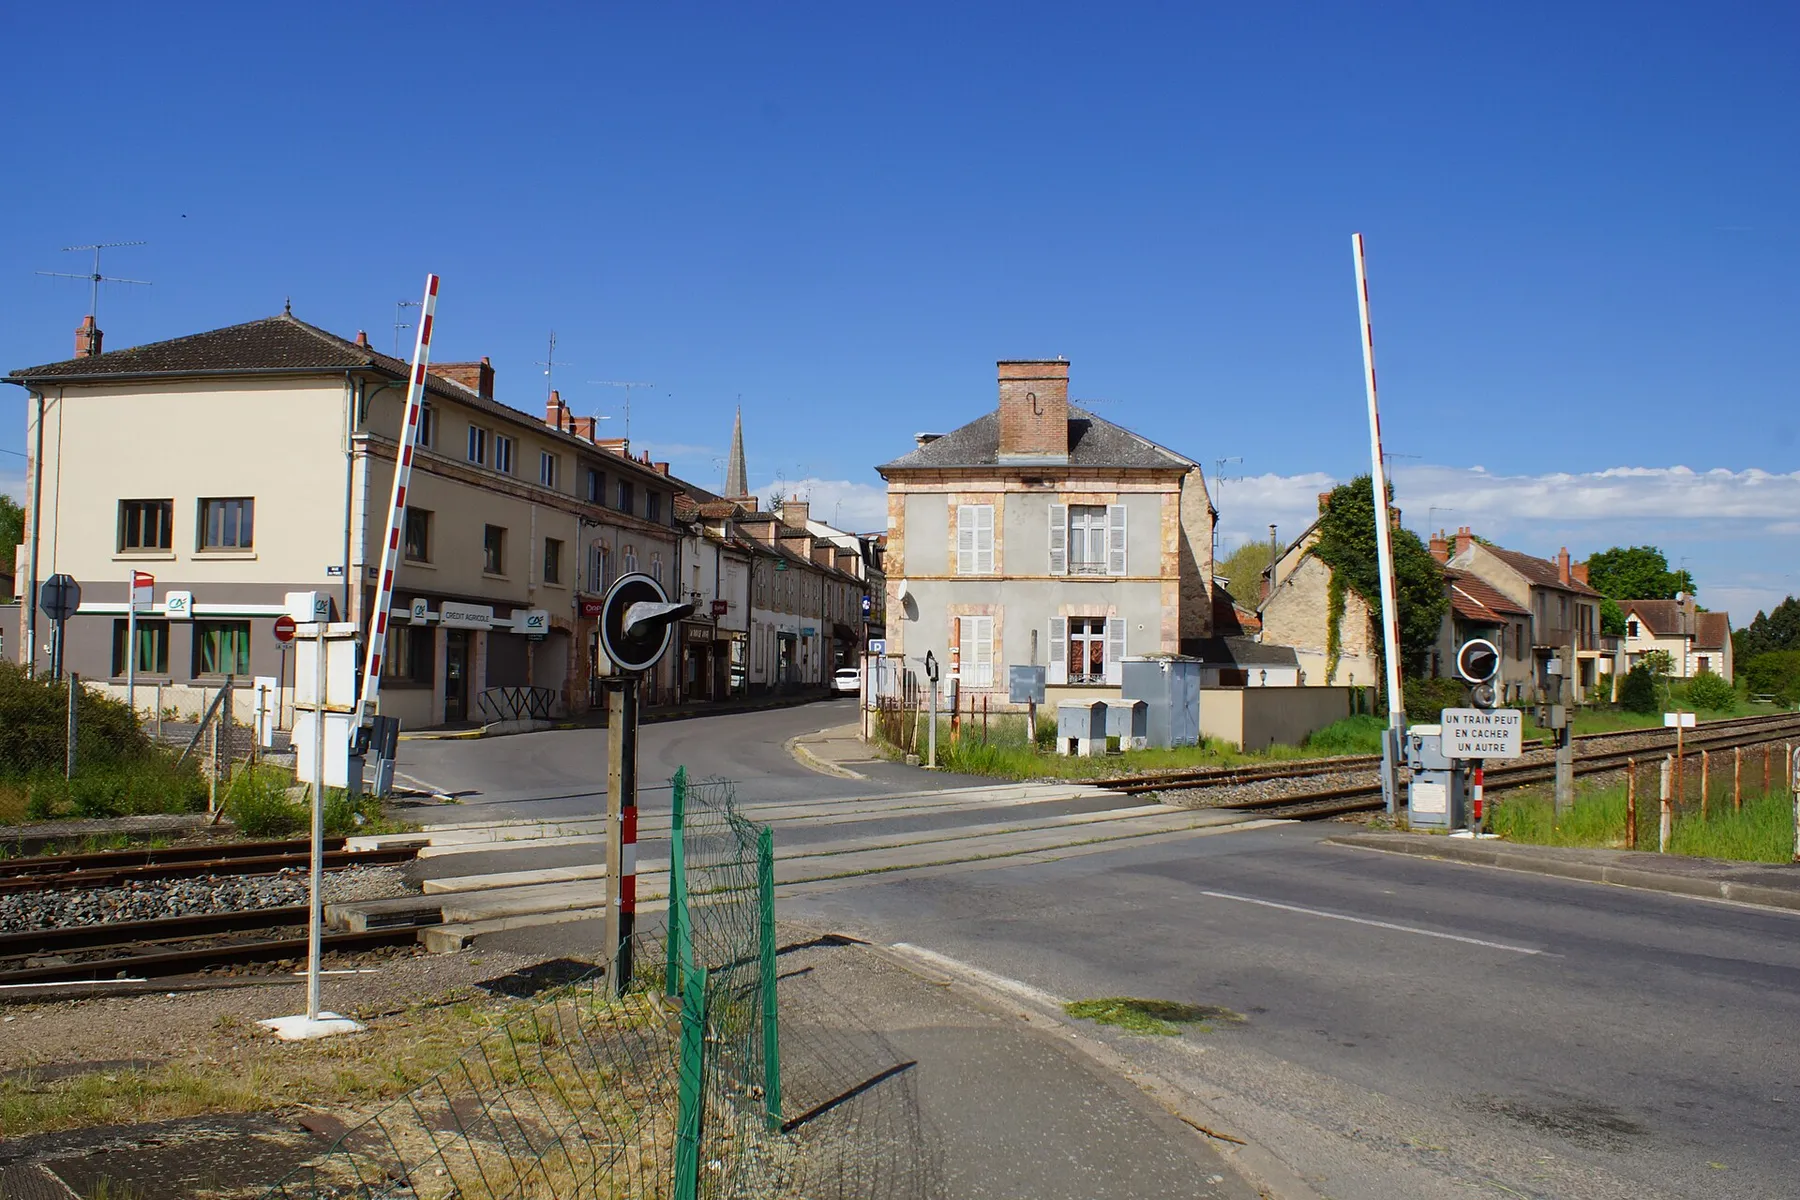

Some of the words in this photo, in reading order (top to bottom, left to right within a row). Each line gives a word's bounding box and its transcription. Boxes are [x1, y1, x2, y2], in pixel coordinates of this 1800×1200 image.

[465, 613, 490, 622] AGRICOLE
[874, 642, 882, 652] P
[1446, 715, 1459, 724] UN
[1463, 715, 1491, 724] TRAIN
[1494, 716, 1519, 725] PEUT
[1455, 729, 1468, 738] EN
[1471, 729, 1509, 738] CACHER
[1458, 743, 1471, 751] UN
[1475, 743, 1506, 752] AUTRE
